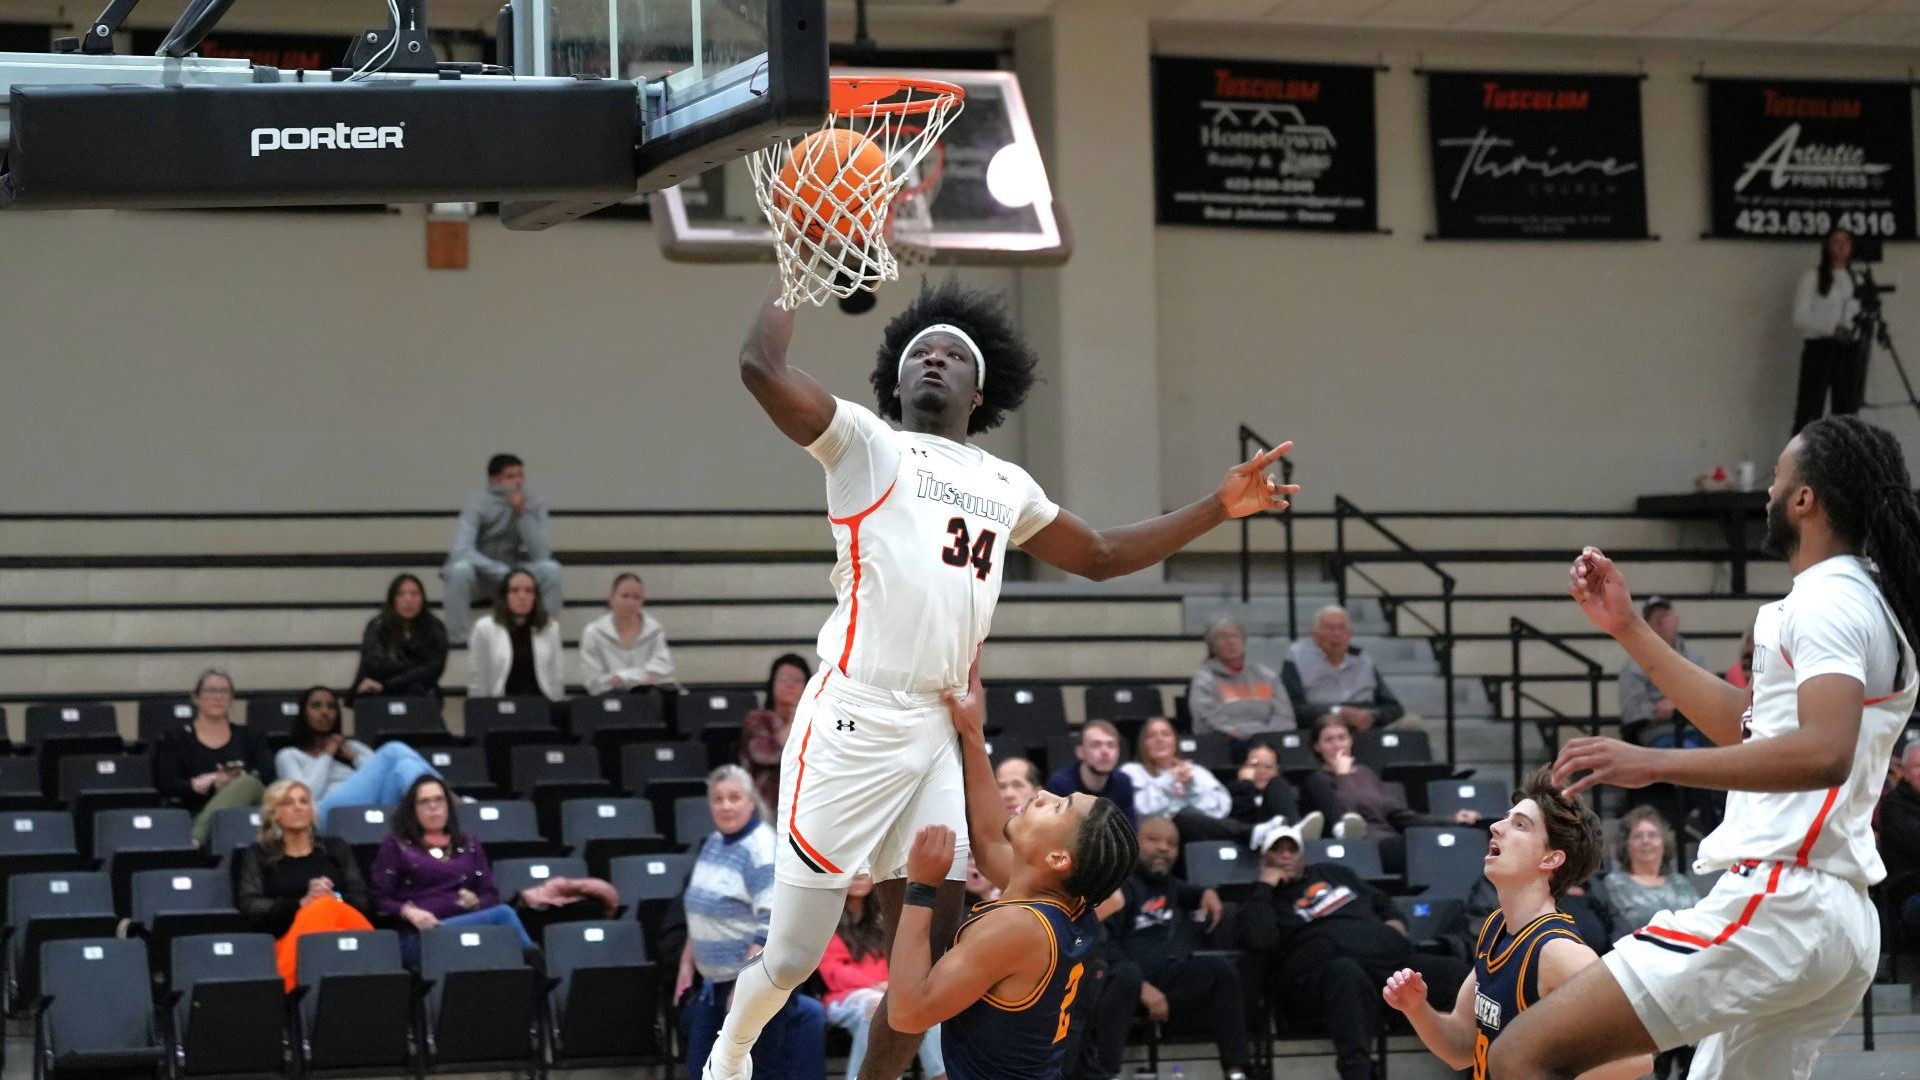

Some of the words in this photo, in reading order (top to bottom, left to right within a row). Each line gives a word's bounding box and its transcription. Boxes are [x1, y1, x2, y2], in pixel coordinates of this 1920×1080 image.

[916, 468, 1014, 530] TUSCULUM
[941, 516, 997, 582] 34
[1051, 962, 1085, 1044] 2
